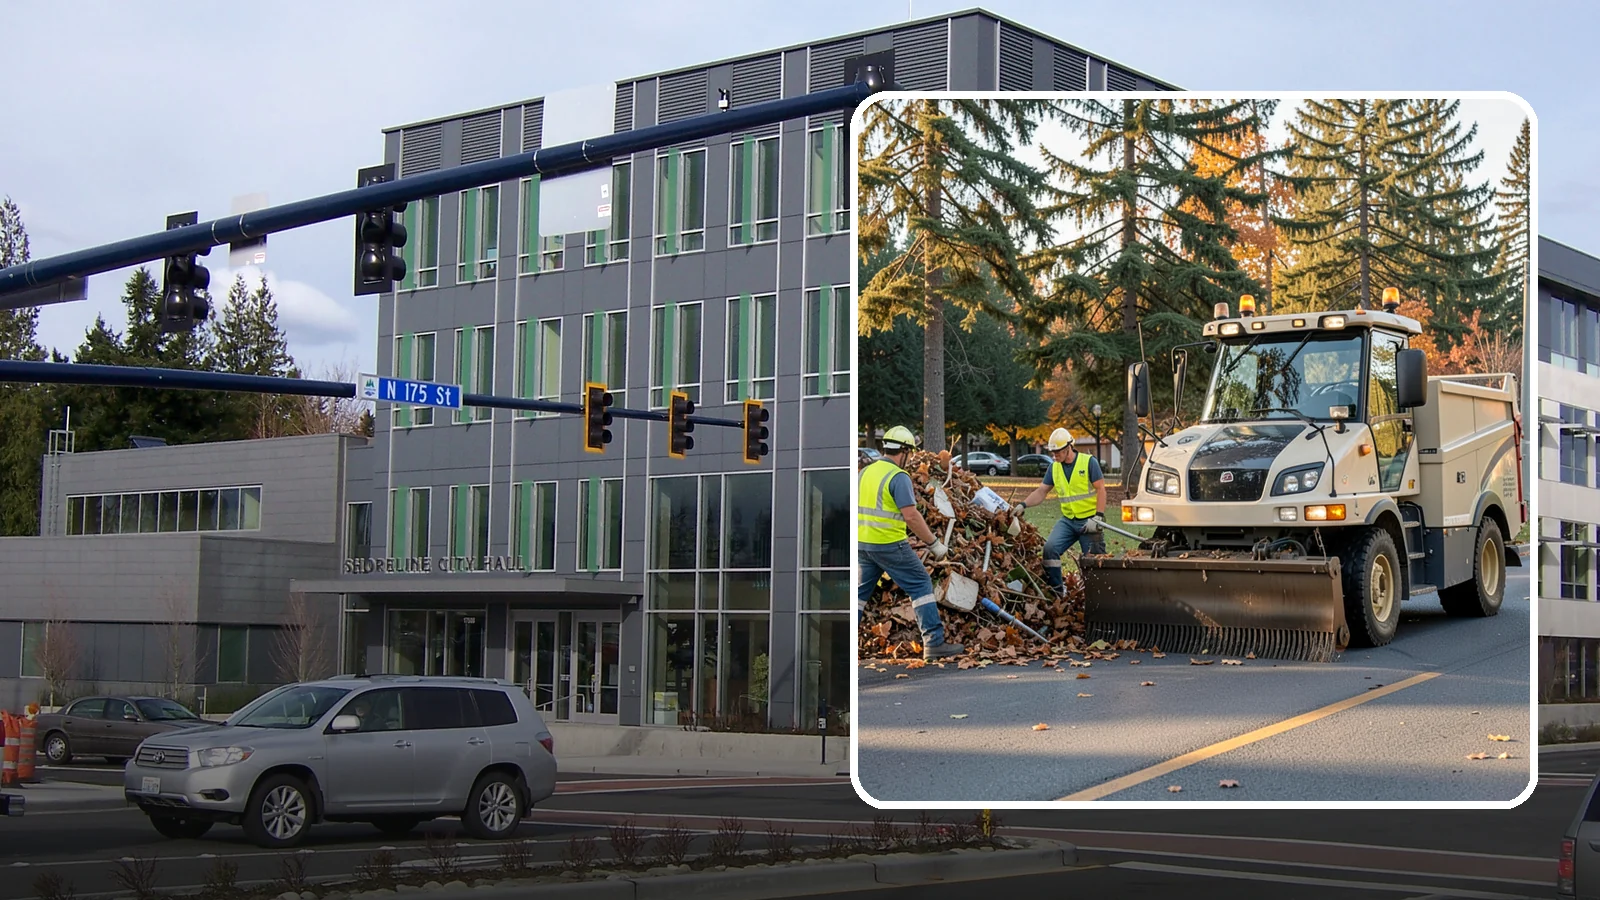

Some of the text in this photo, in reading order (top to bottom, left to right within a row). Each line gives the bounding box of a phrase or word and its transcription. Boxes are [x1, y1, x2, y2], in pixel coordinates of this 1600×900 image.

[387, 380, 451, 405] N 175 St
[343, 556, 525, 574] SHORELINE CITY HALL
